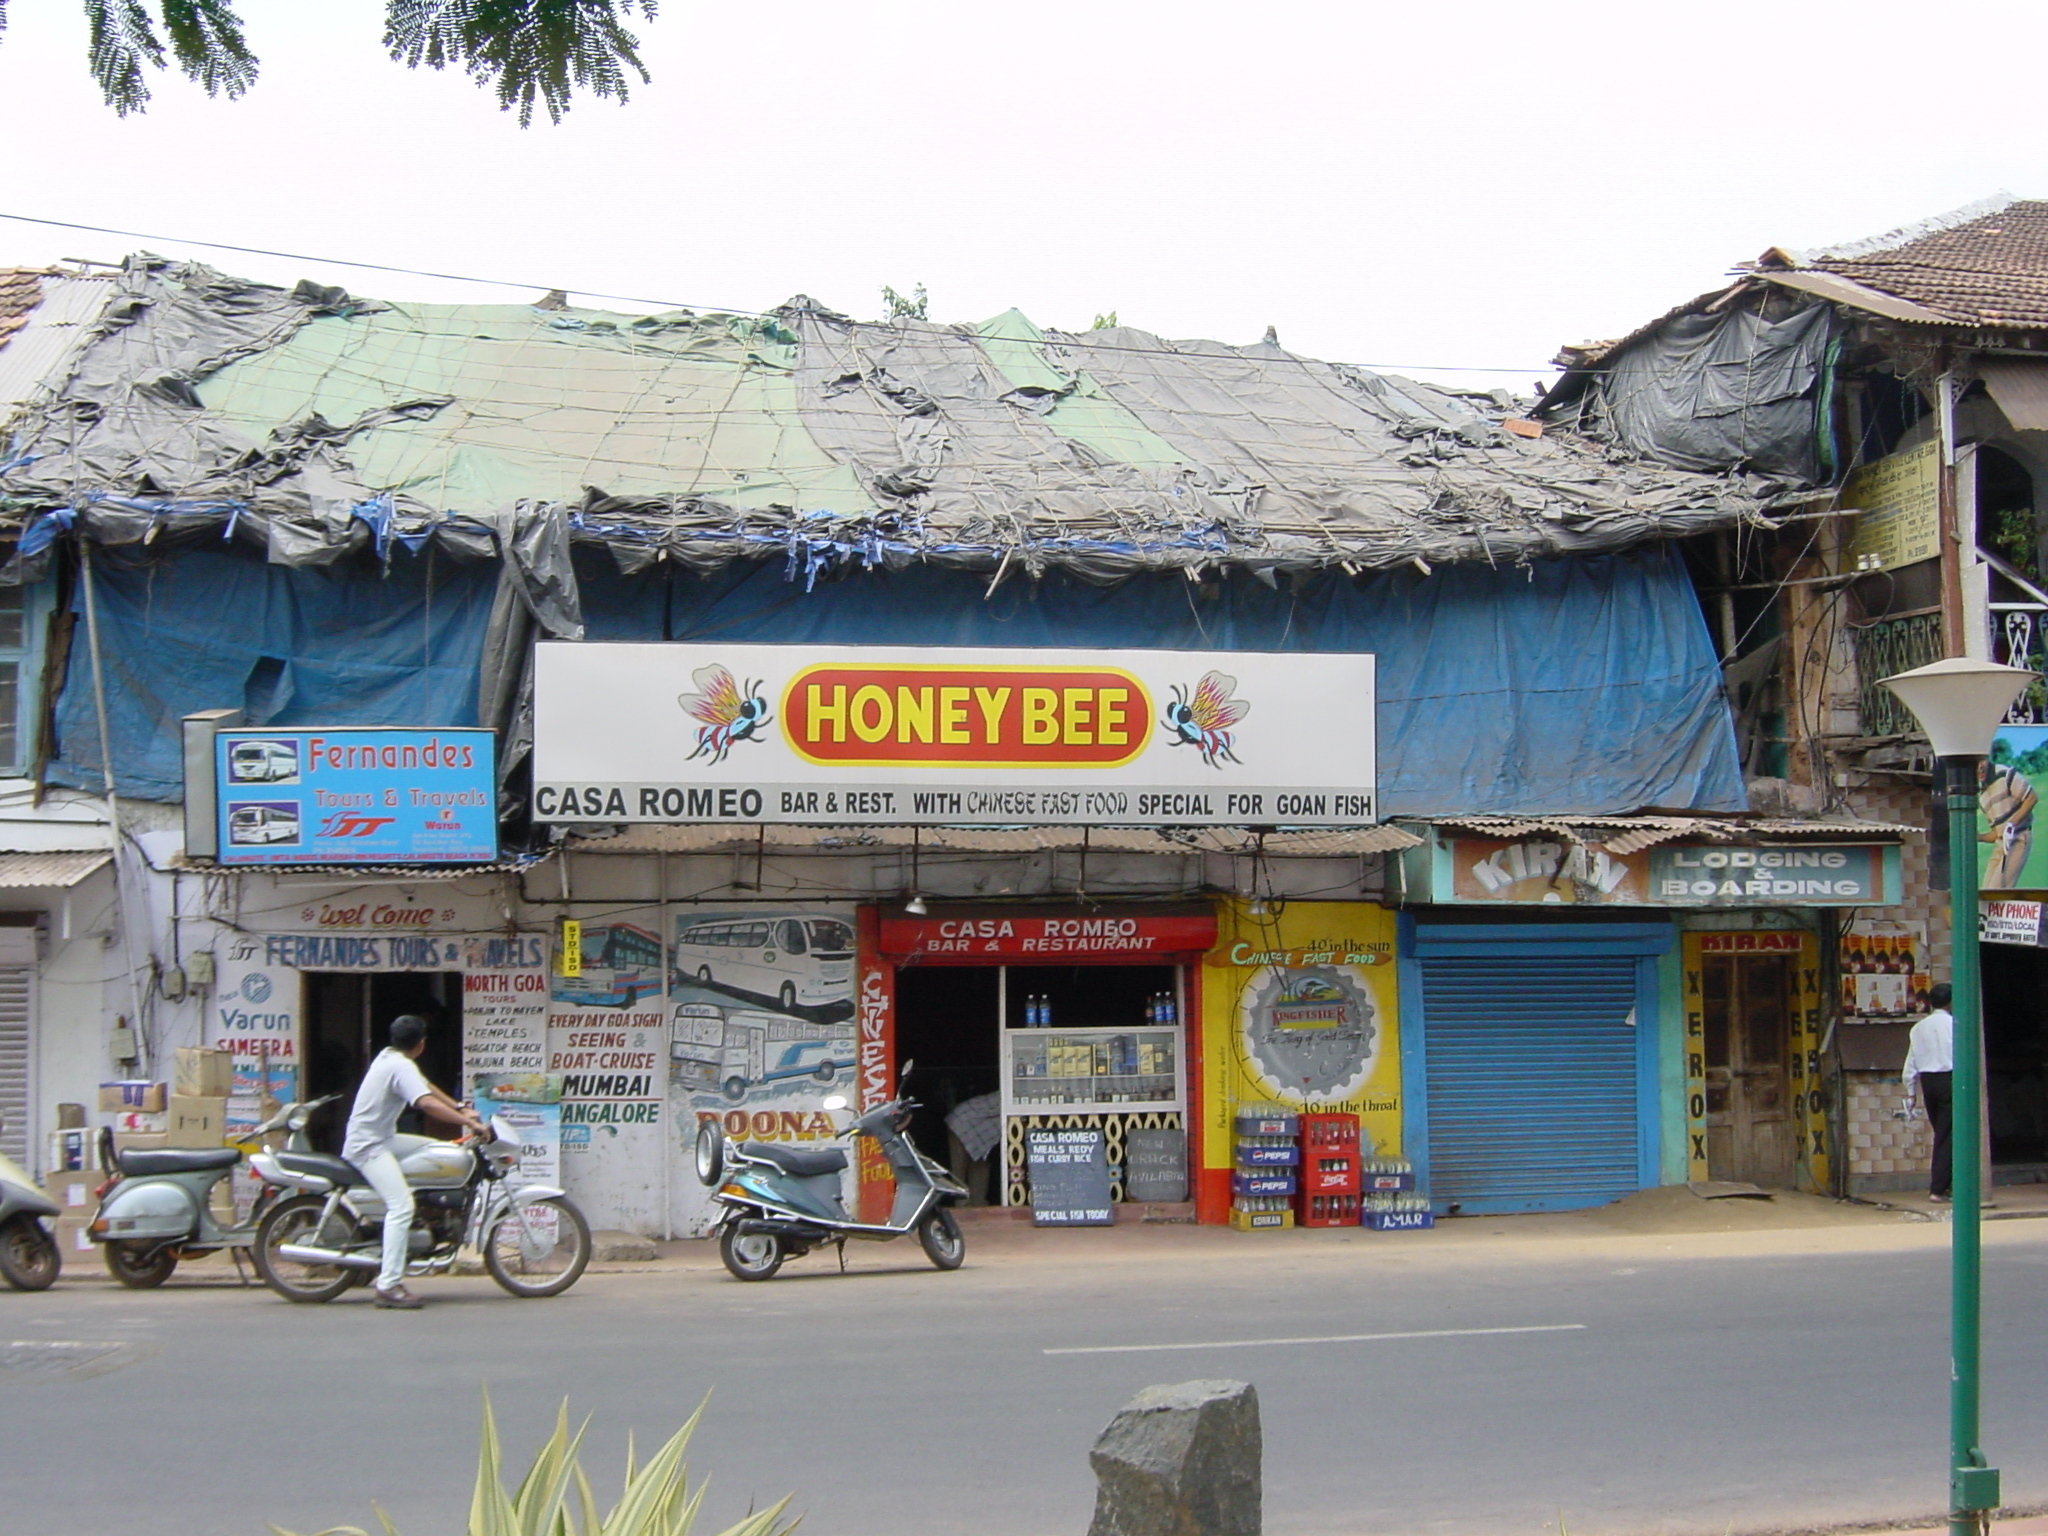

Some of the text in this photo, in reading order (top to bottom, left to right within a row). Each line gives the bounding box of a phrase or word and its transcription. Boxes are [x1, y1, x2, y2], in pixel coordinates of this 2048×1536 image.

[806, 684, 1128, 745] HONEY BEE
[308, 738, 474, 772] Fernandes
[314, 788, 486, 807] Tours & Travels
[535, 786, 1371, 817] CASA ROMEO BAR & REST. WITH CHINESE FAST FOOD SPECIAL FOR GOAN FISH
[1472, 842, 1630, 893] KIRAN
[1673, 852, 1848, 868] LODGING
[1753, 867, 1775, 880] &
[1661, 880, 1860, 896] BOARDING
[1988, 903, 2039, 920] PAY PHONE
[940, 919, 1137, 938] CASA ROMEO
[567, 926, 578, 972] STD ISD
[927, 937, 1155, 951] BAR & RESTAURANT
[1330, 940, 1342, 952] in
[1345, 940, 1365, 952] the
[1367, 942, 1390, 952] sun
[1701, 934, 1803, 951] KIRAN
[265, 936, 380, 968] FERNANDES
[387, 938, 440, 968] TOURS
[444, 943, 459, 961] &
[1231, 943, 1376, 965] CHINESE FAST FOOD
[464, 974, 545, 992] NORTH GOA
[219, 1009, 291, 1031] Varun
[485, 1018, 517, 1026] LAKE
[548, 1012, 663, 1029] EVERY DAY GOA SIGHT
[1272, 1006, 1348, 1026] KINGFISHER
[473, 1028, 528, 1039] TEMPLES
[567, 1032, 647, 1048] SEEING &
[512, 1043, 543, 1053] BEACH
[510, 1057, 543, 1068] BEACH
[1687, 971, 1706, 1160] XEROX
[1803, 968, 1826, 1156] XEROX
[561, 1075, 652, 1097] MUMBAI
[560, 1103, 660, 1124] ANGALORE
[1325, 1102, 1338, 1114] in
[1340, 1100, 1359, 1112] the
[1363, 1099, 1397, 1111] throat
[1030, 1132, 1098, 1143] CASA ROMEO
[1033, 1145, 1095, 1154] MEALS REDY
[1264, 1152, 1290, 1160] PEPSI
[1261, 1181, 1288, 1190] PEPSI
